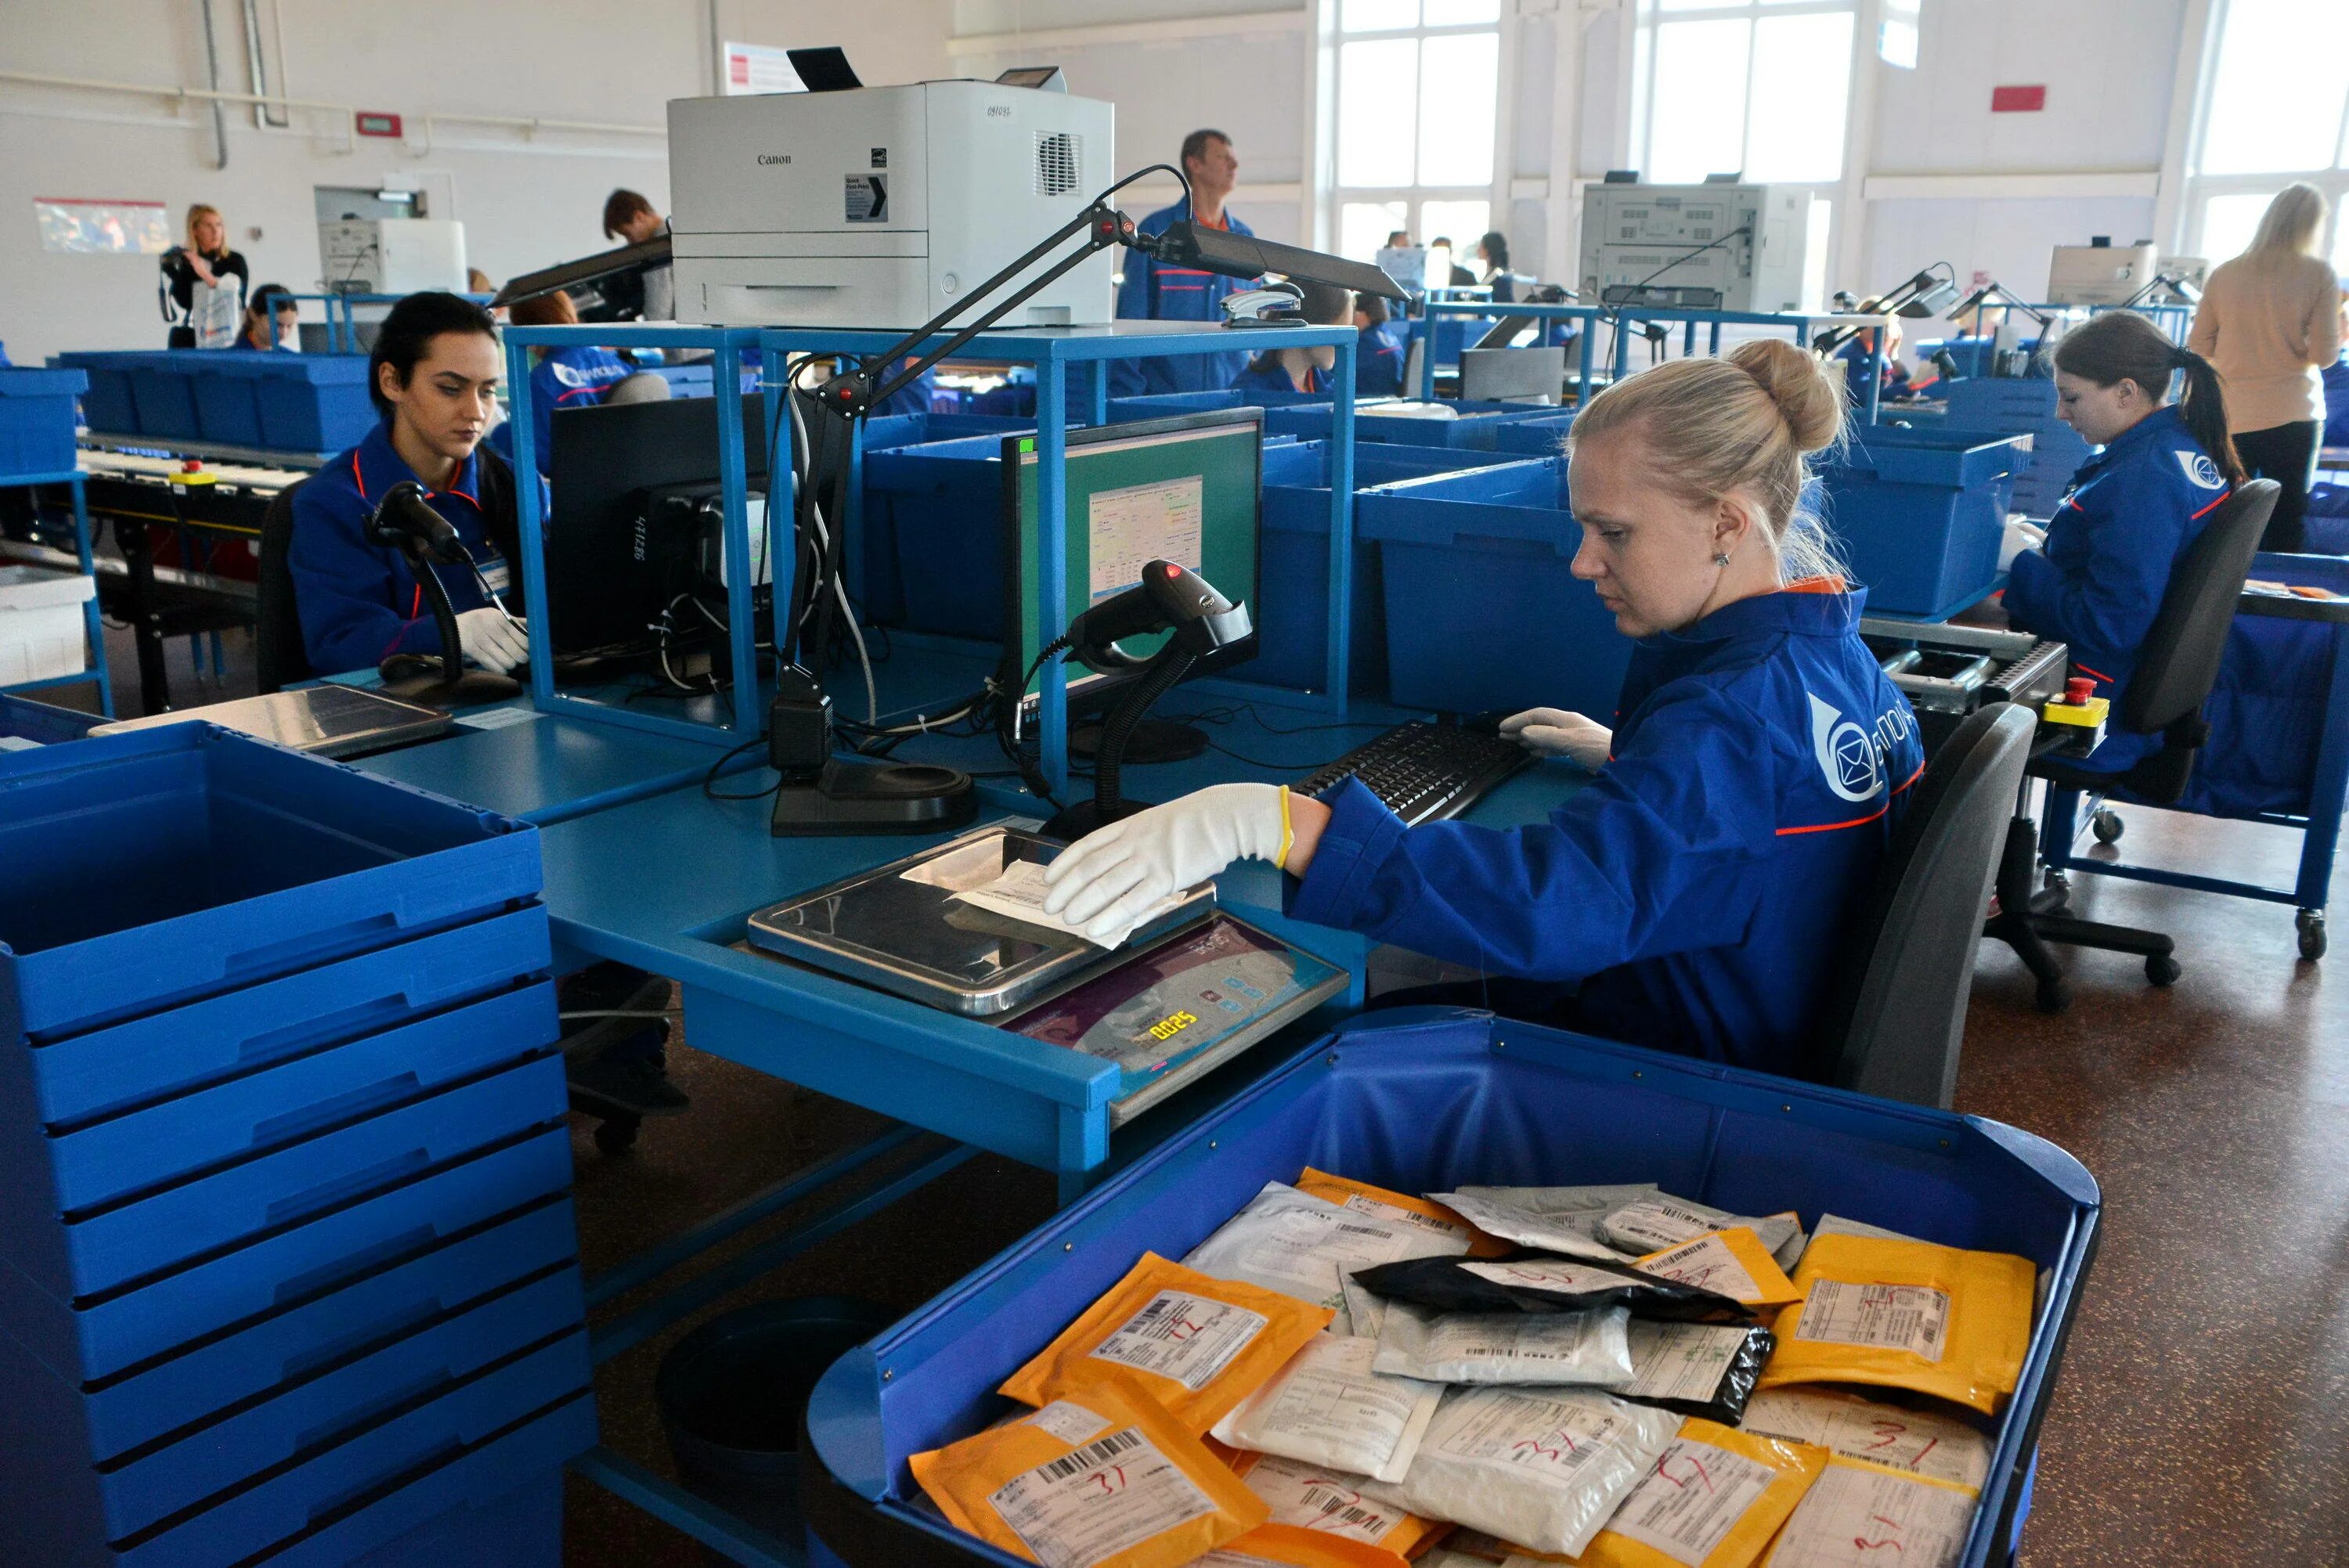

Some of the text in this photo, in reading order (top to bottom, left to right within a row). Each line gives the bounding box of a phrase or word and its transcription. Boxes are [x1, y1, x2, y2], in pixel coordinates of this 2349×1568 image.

[758, 154, 791, 164] Canon
[1865, 1421, 1938, 1466] 31
[1088, 1465, 1126, 1494] 31
